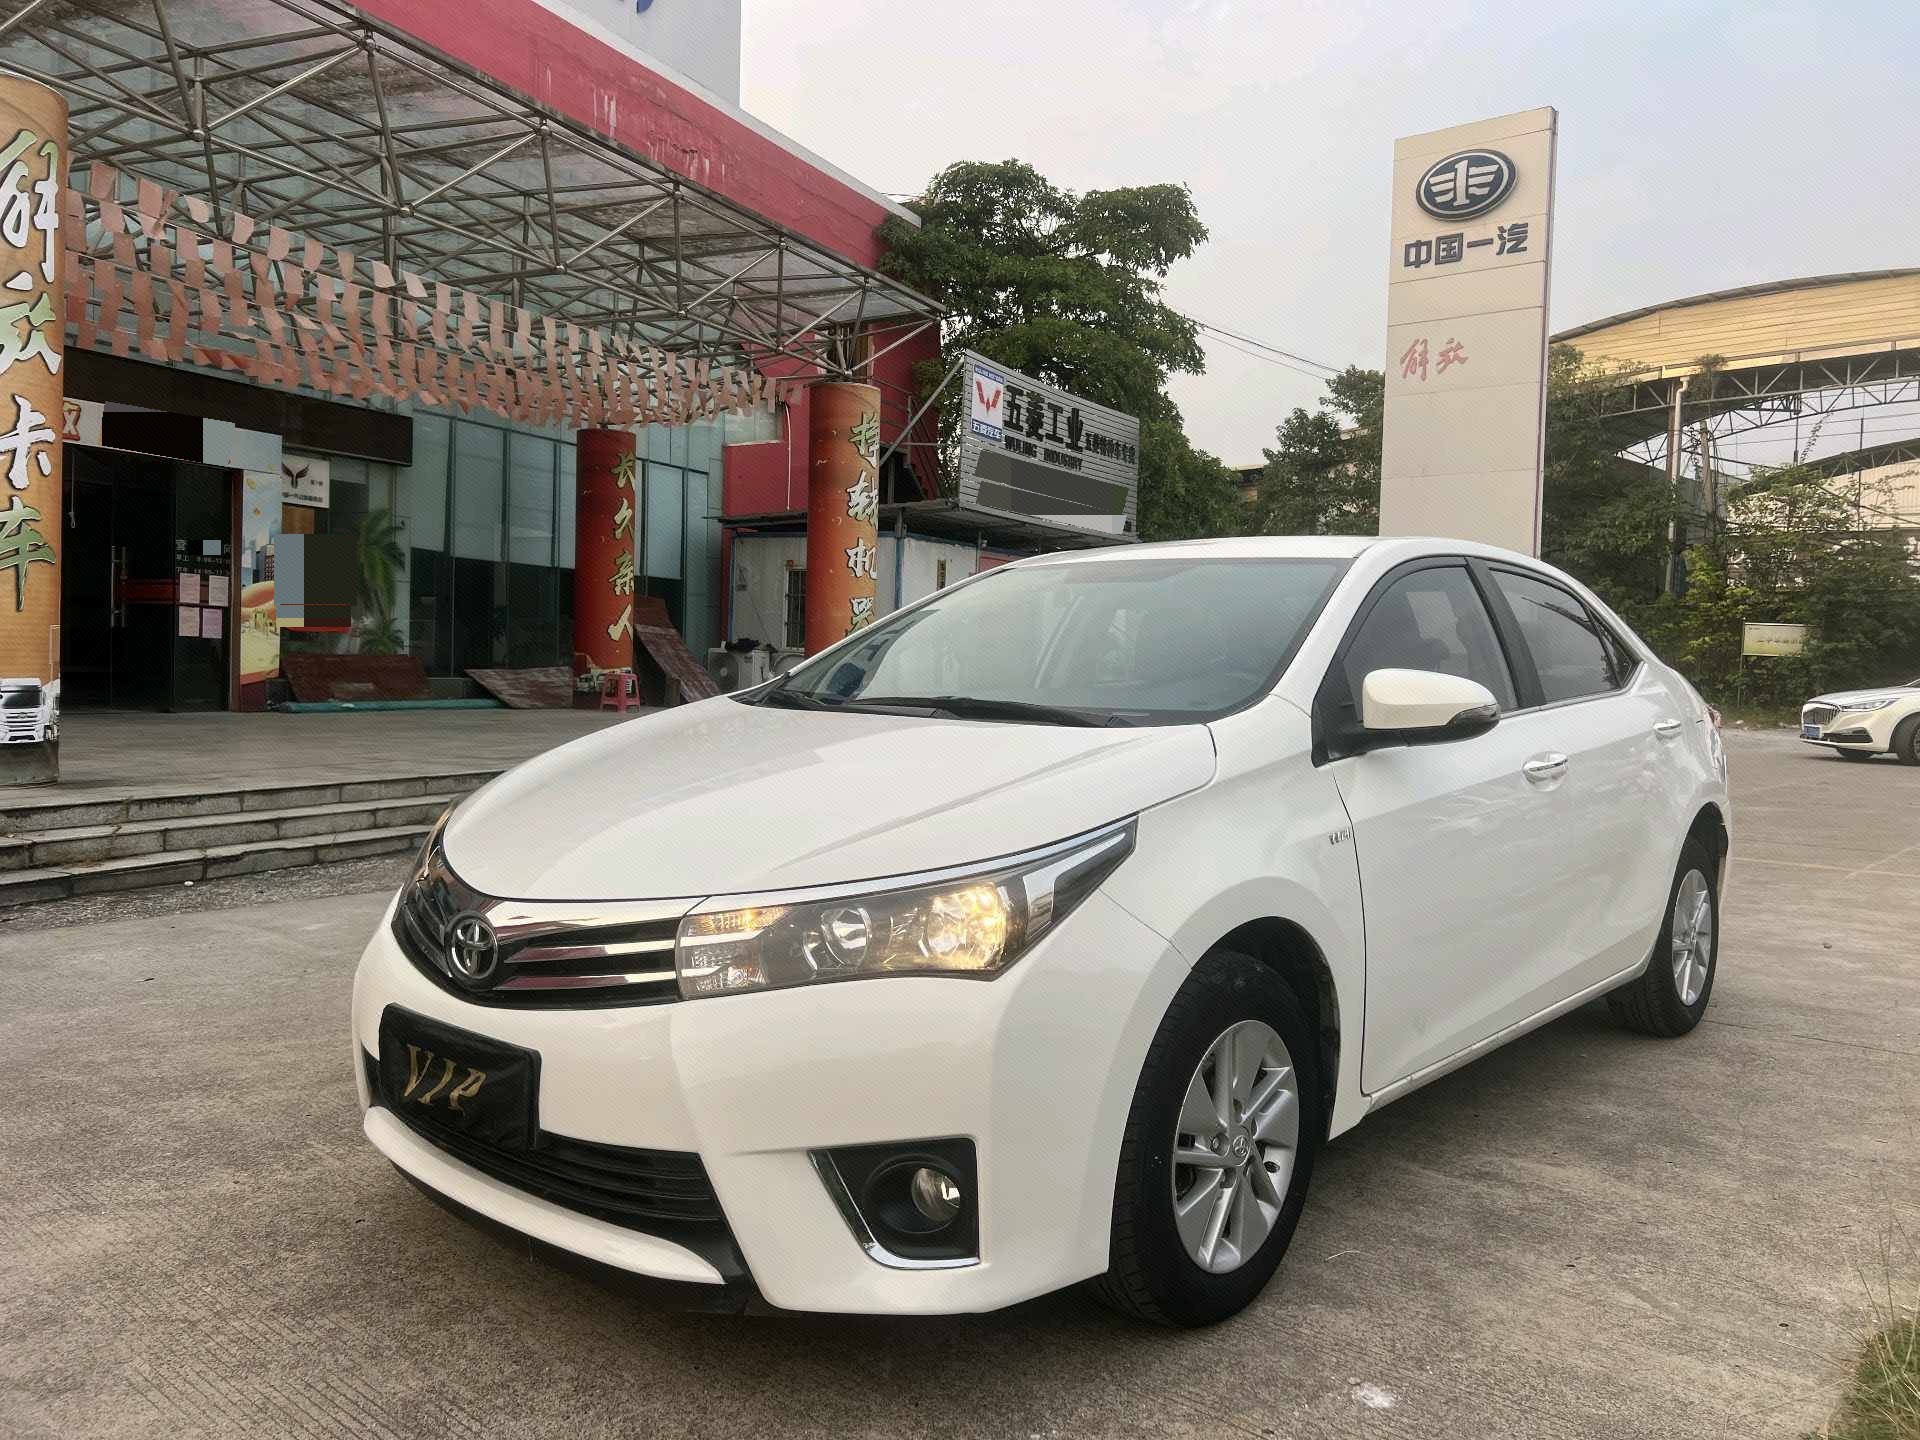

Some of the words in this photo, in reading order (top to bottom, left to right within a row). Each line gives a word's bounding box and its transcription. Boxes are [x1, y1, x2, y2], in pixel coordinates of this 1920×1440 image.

[1404, 222, 1529, 268] 中国一汽
[1400, 338, 1469, 381] 解放
[1003, 385, 1084, 453] 五菱工业
